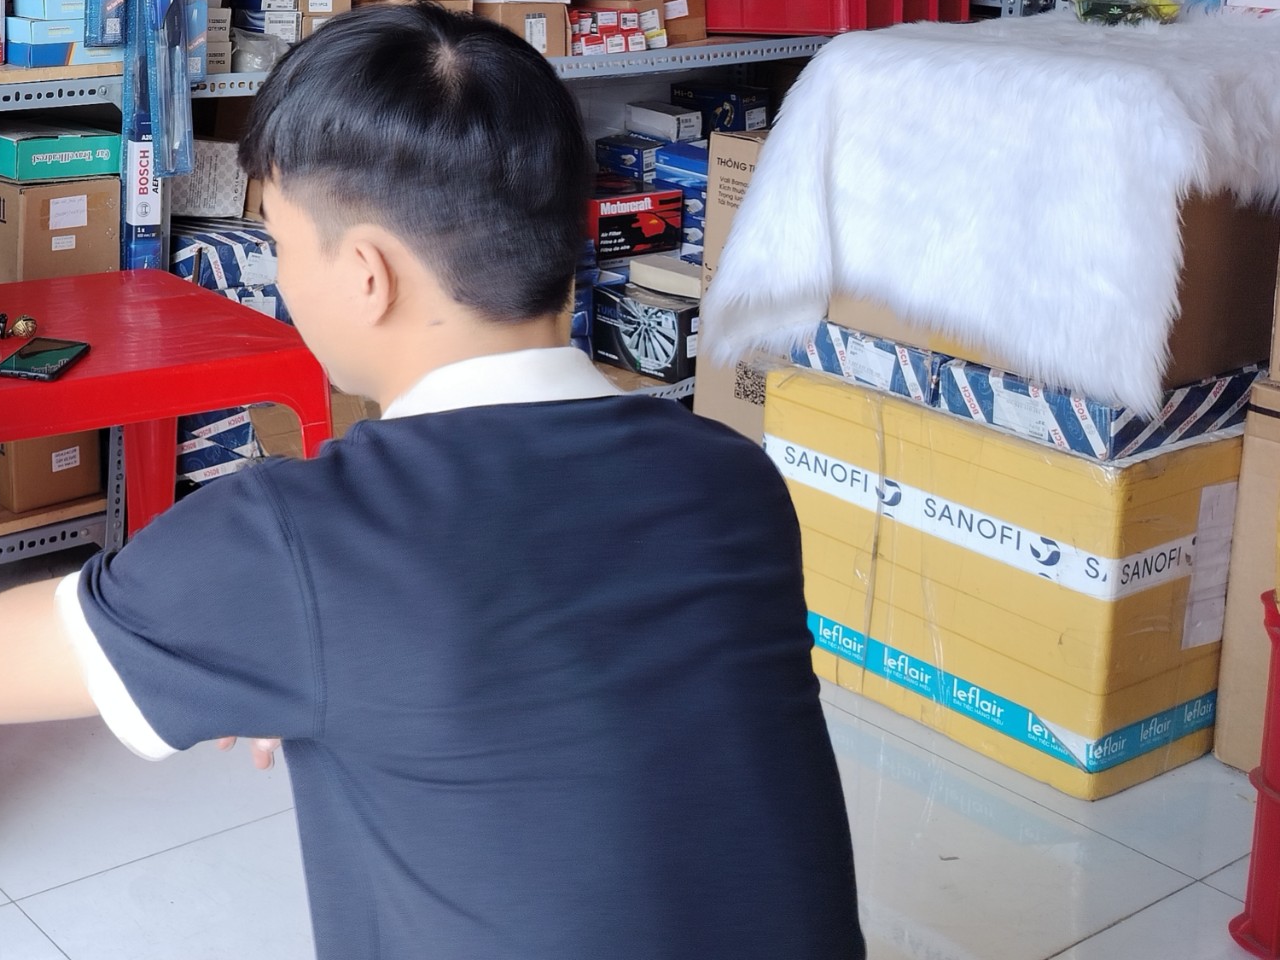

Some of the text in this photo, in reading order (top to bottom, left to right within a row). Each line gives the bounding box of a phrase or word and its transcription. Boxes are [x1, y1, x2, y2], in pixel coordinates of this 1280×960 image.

[96, 149, 111, 159] Car
[716, 156, 747, 171] THÔNG
[138, 149, 150, 195] BOSCH
[719, 176, 730, 184] Vali
[600, 196, 653, 216] Motorcraft
[962, 385, 979, 415] BOSCH
[228, 416, 245, 427] BOSCH
[1178, 413, 1198, 434] BOSCH
[784, 445, 869, 493] SANOFI
[923, 497, 1021, 551] SANOFI
[1121, 545, 1182, 585] SANOFI
[820, 617, 864, 654] leflair
[883, 646, 932, 685] leflair
[953, 678, 1004, 719] leflair
[1184, 698, 1213, 724] leflair
[963, 702, 974, 712] TIỆC
[974, 708, 990, 720] HÀNG
[990, 715, 1004, 726] HIỆU
[1038, 737, 1049, 747] TIỆC
[1140, 717, 1172, 742] leflair
[1088, 736, 1127, 760] leflair
